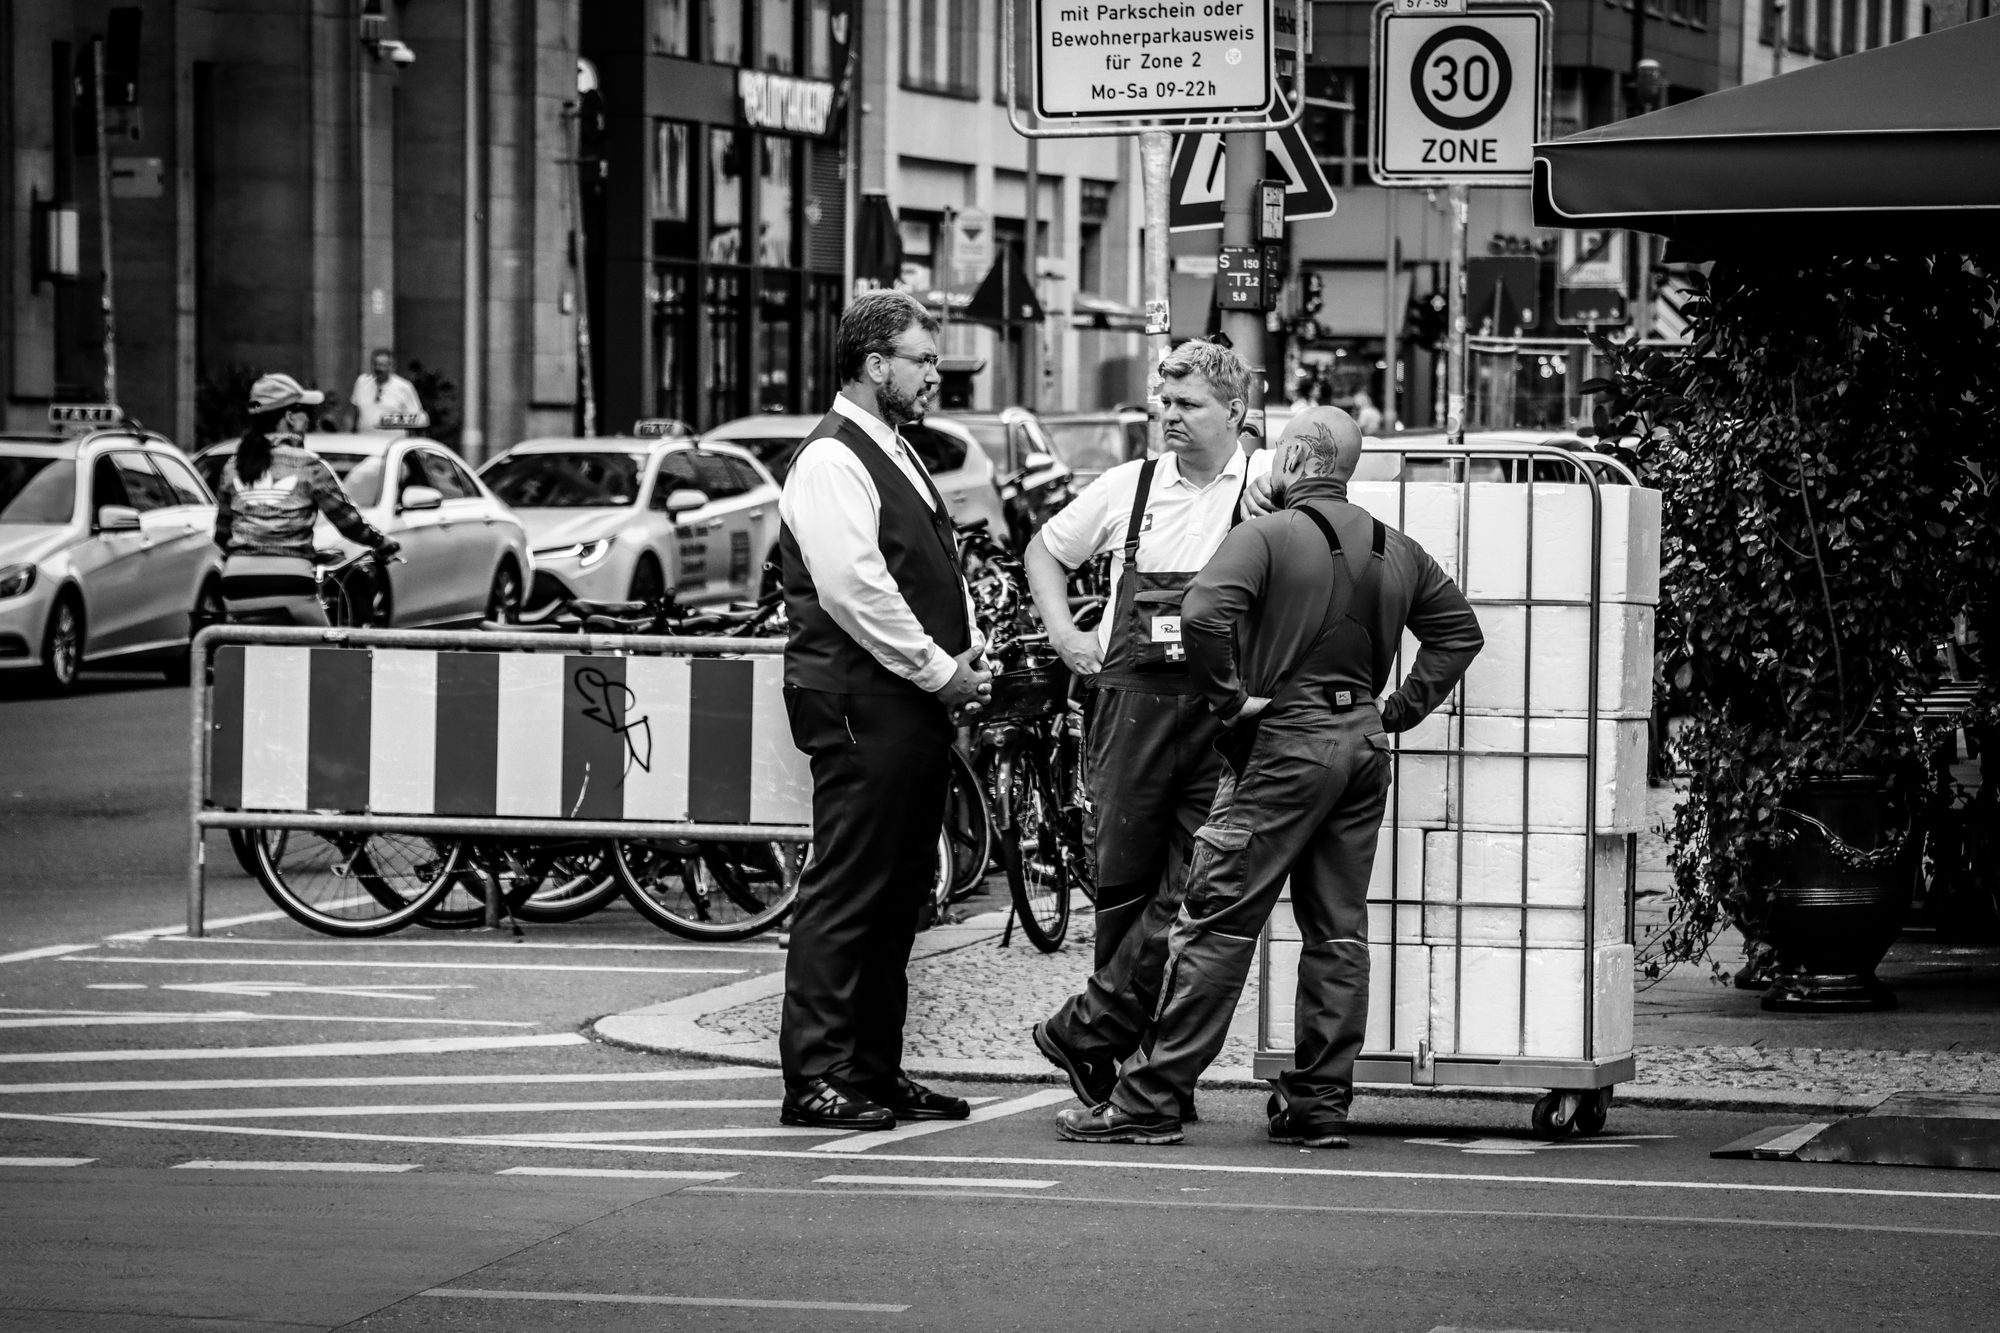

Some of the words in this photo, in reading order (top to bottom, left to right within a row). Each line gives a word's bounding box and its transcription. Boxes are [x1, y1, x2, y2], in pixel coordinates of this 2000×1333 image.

[1061, 5, 1089, 22] mit
[1097, 1, 1195, 20] Parkschein
[1203, 0, 1244, 17] oder
[1051, 24, 1255, 48] Bewohnerparkausweis
[1105, 54, 1131, 71] für
[1140, 53, 1183, 70] Zone
[1191, 51, 1202, 68] 2
[1431, 55, 1489, 102] 30
[1091, 82, 1148, 100] Mo-Sa
[1156, 80, 1216, 98] 09-22h
[1421, 138, 1498, 164] ZONE
[1219, 254, 1231, 269] S
[1243, 259, 1260, 269] 150
[58, 406, 107, 423] TAXI
